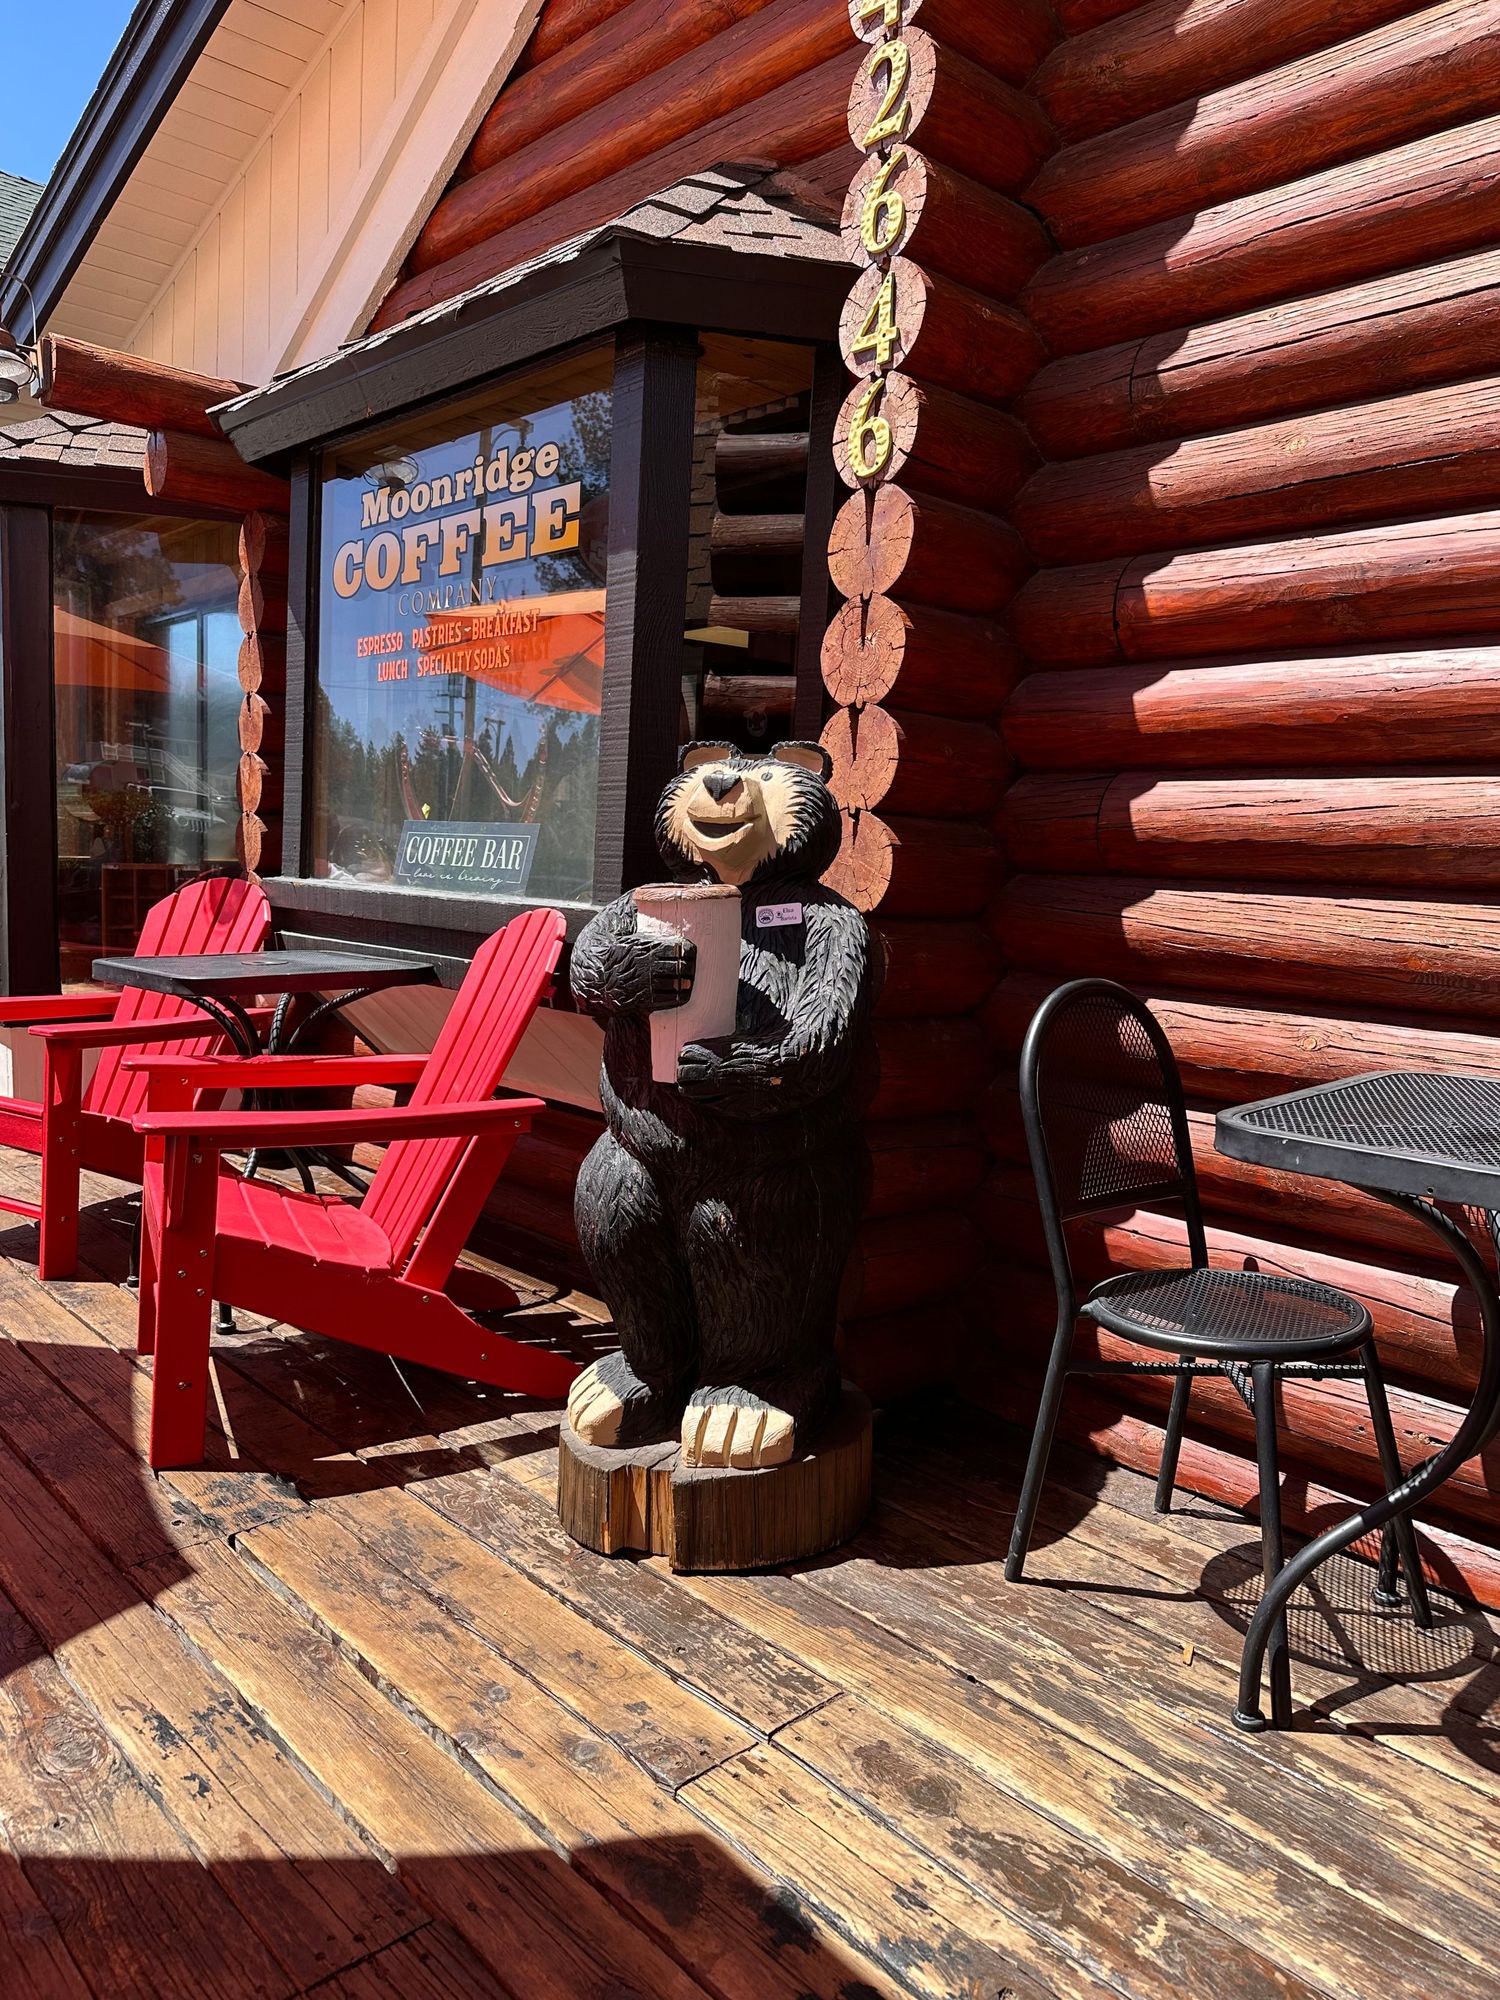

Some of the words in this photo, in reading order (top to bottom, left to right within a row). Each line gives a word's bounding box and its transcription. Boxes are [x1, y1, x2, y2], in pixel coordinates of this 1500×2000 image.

[847, 0, 911, 478] 2646
[361, 441, 560, 529] Moonridge
[333, 481, 581, 600] COFFEE
[398, 575, 498, 616] COMPANY
[357, 631, 403, 657] ESPRESSO
[412, 621, 462, 649] PASTRIES
[472, 608, 540, 642] BREAKFAST
[377, 659, 408, 682] LUNCH
[417, 650, 472, 678] SPECIALTY
[473, 645, 511, 671] SODAS
[406, 835, 478, 867] COFFEE
[480, 839, 523, 870] BAR
